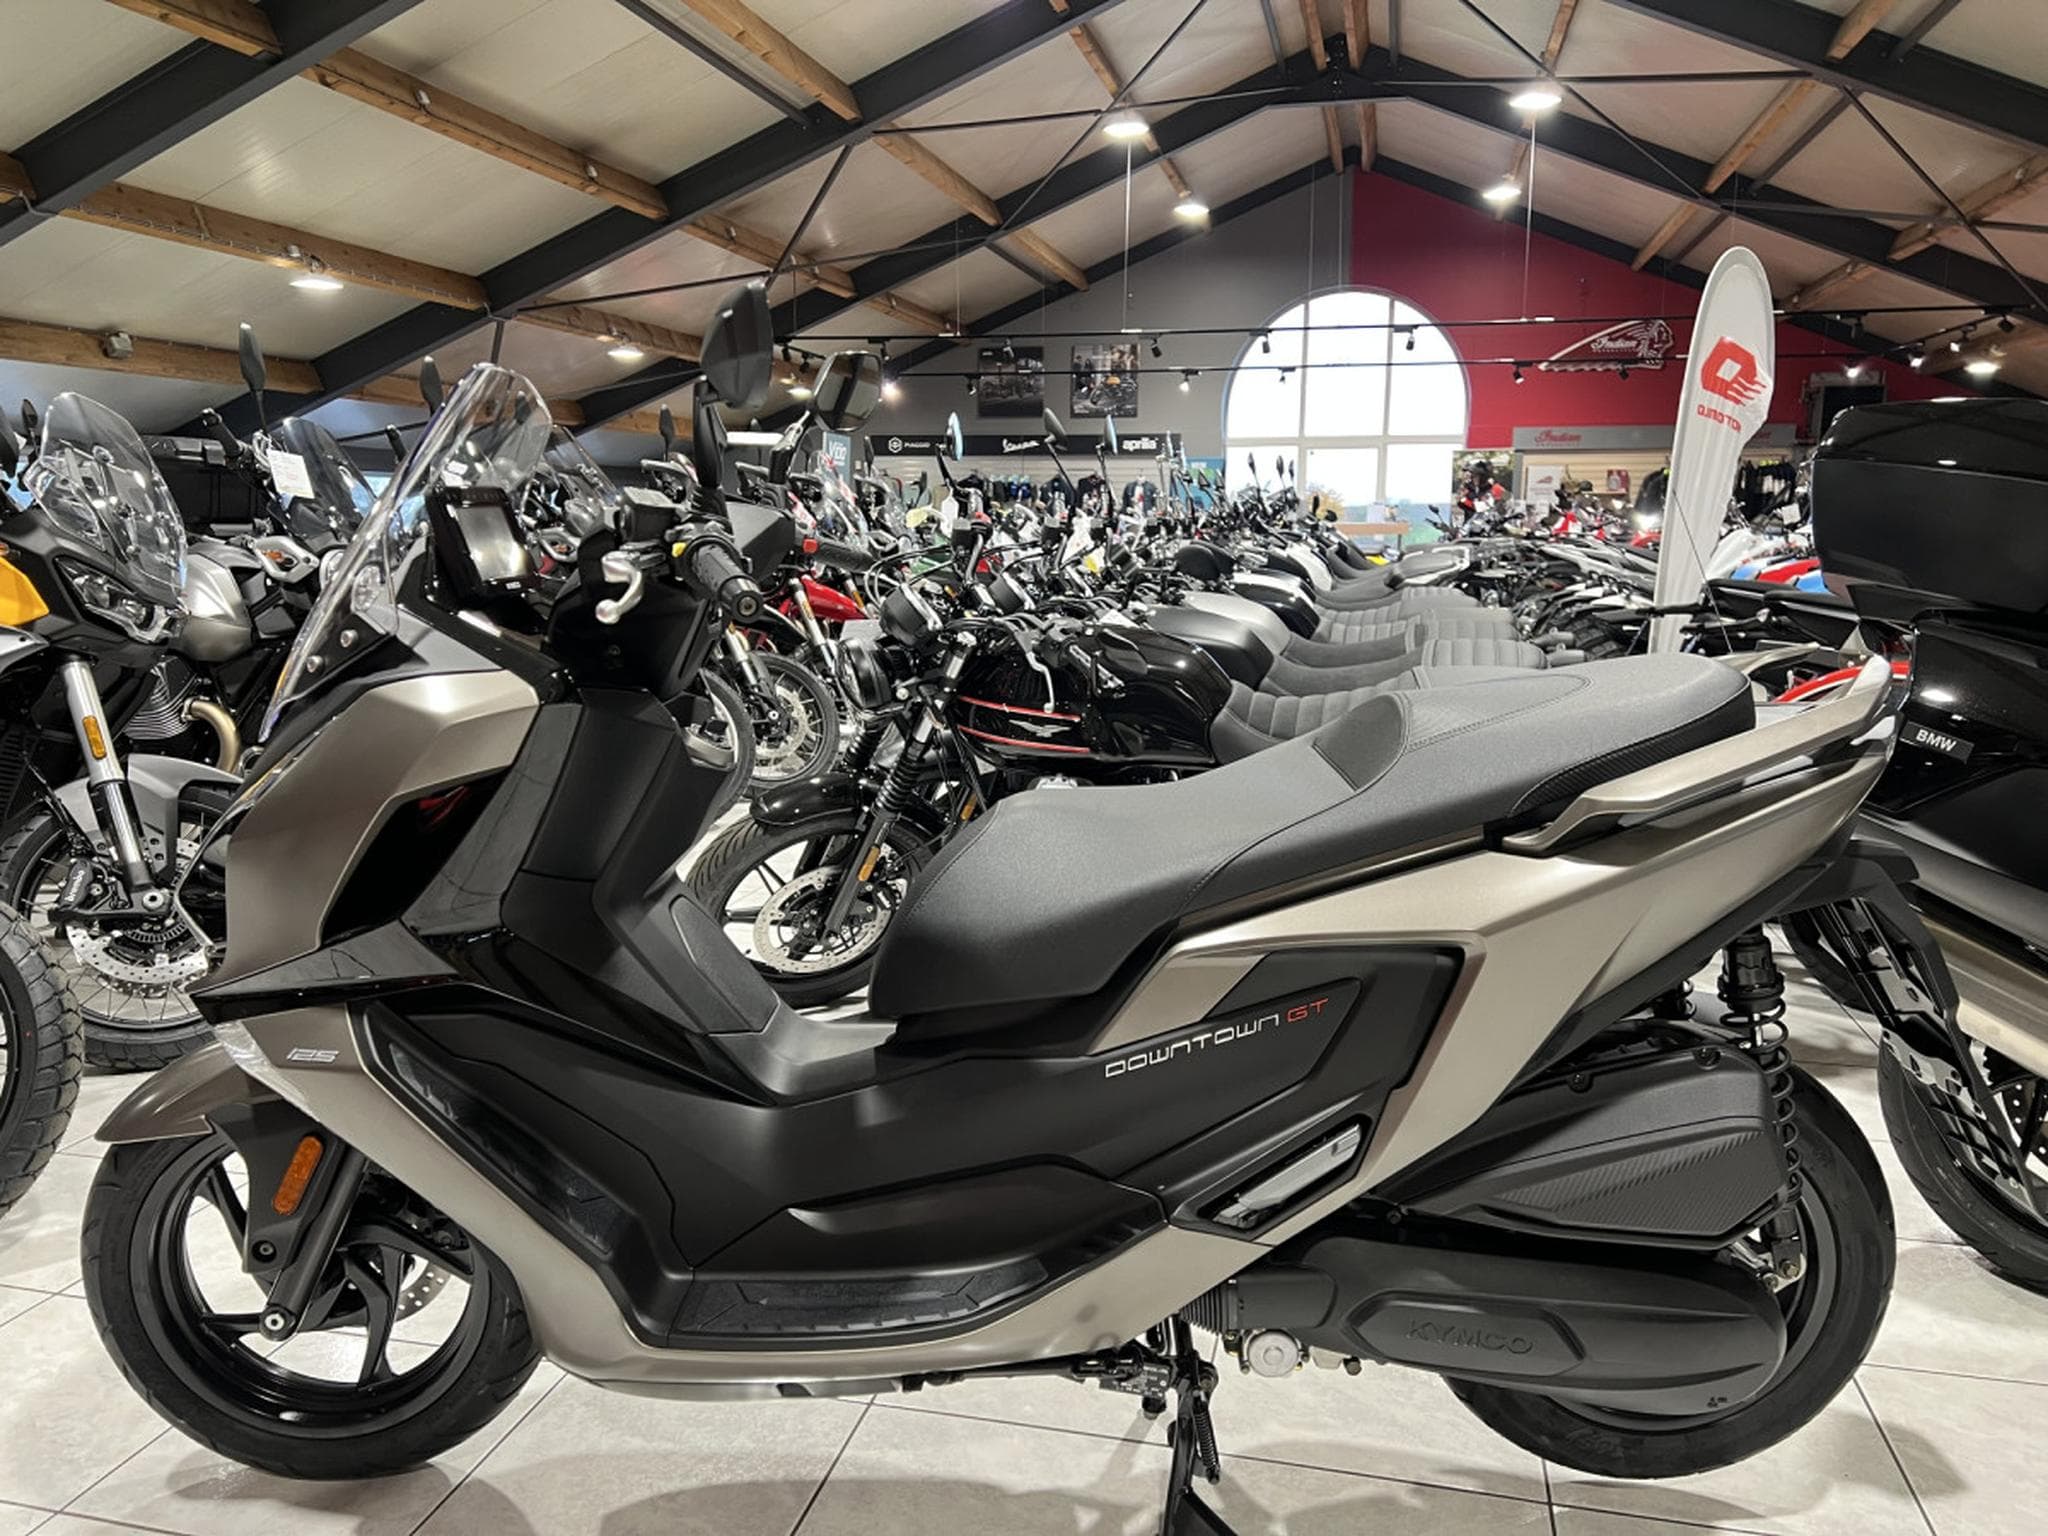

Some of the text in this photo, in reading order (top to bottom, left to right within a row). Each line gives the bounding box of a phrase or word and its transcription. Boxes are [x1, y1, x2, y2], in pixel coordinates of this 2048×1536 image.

[1915, 728, 1957, 752] BMW
[1104, 998, 1329, 1078] DOWNTOWN GT
[1405, 1319, 1534, 1355] KYMCO
